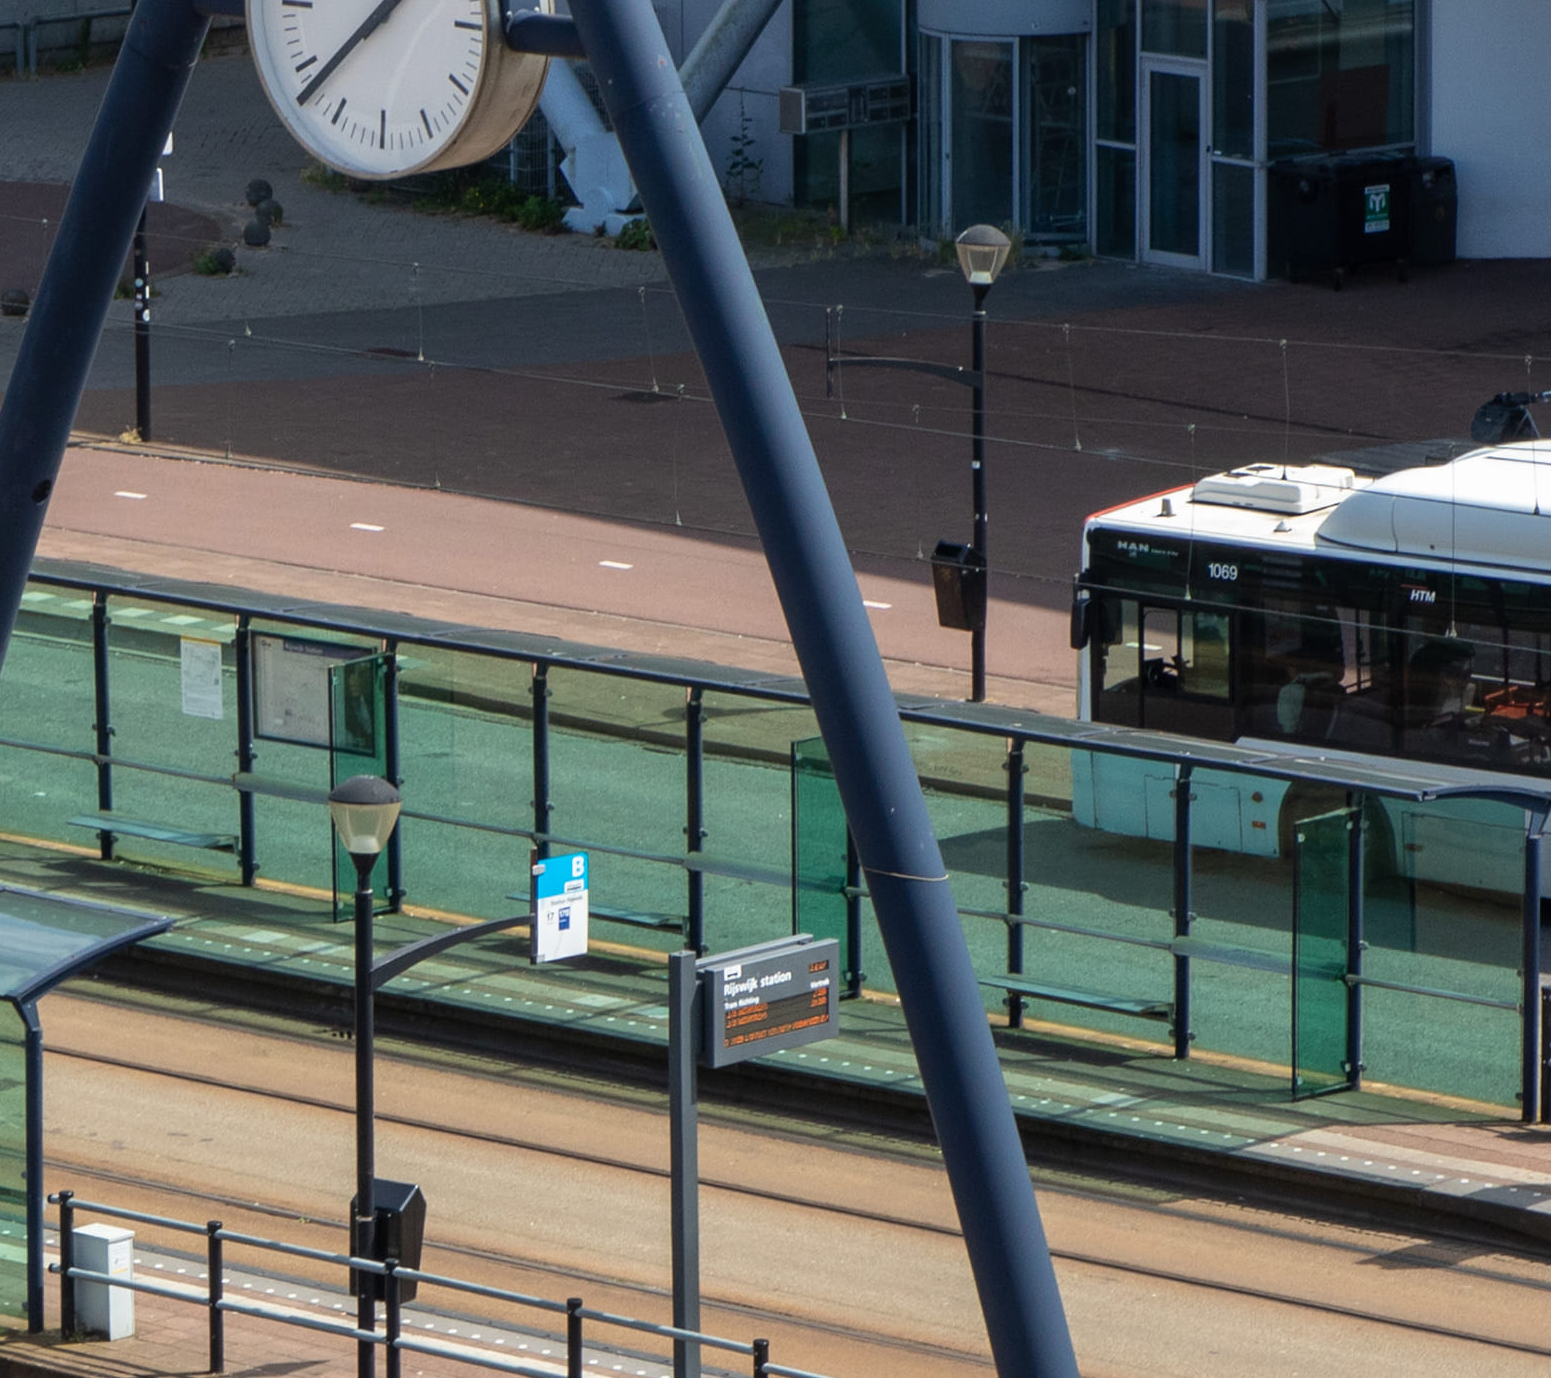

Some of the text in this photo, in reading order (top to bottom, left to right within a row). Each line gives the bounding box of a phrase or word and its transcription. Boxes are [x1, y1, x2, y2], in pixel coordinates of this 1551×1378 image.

[1208, 562, 1238, 580] 1069
[1410, 589, 1436, 603] HTM
[572, 856, 585, 877] B
[547, 912, 555, 922] 17
[724, 971, 792, 997] Rijswijk station
